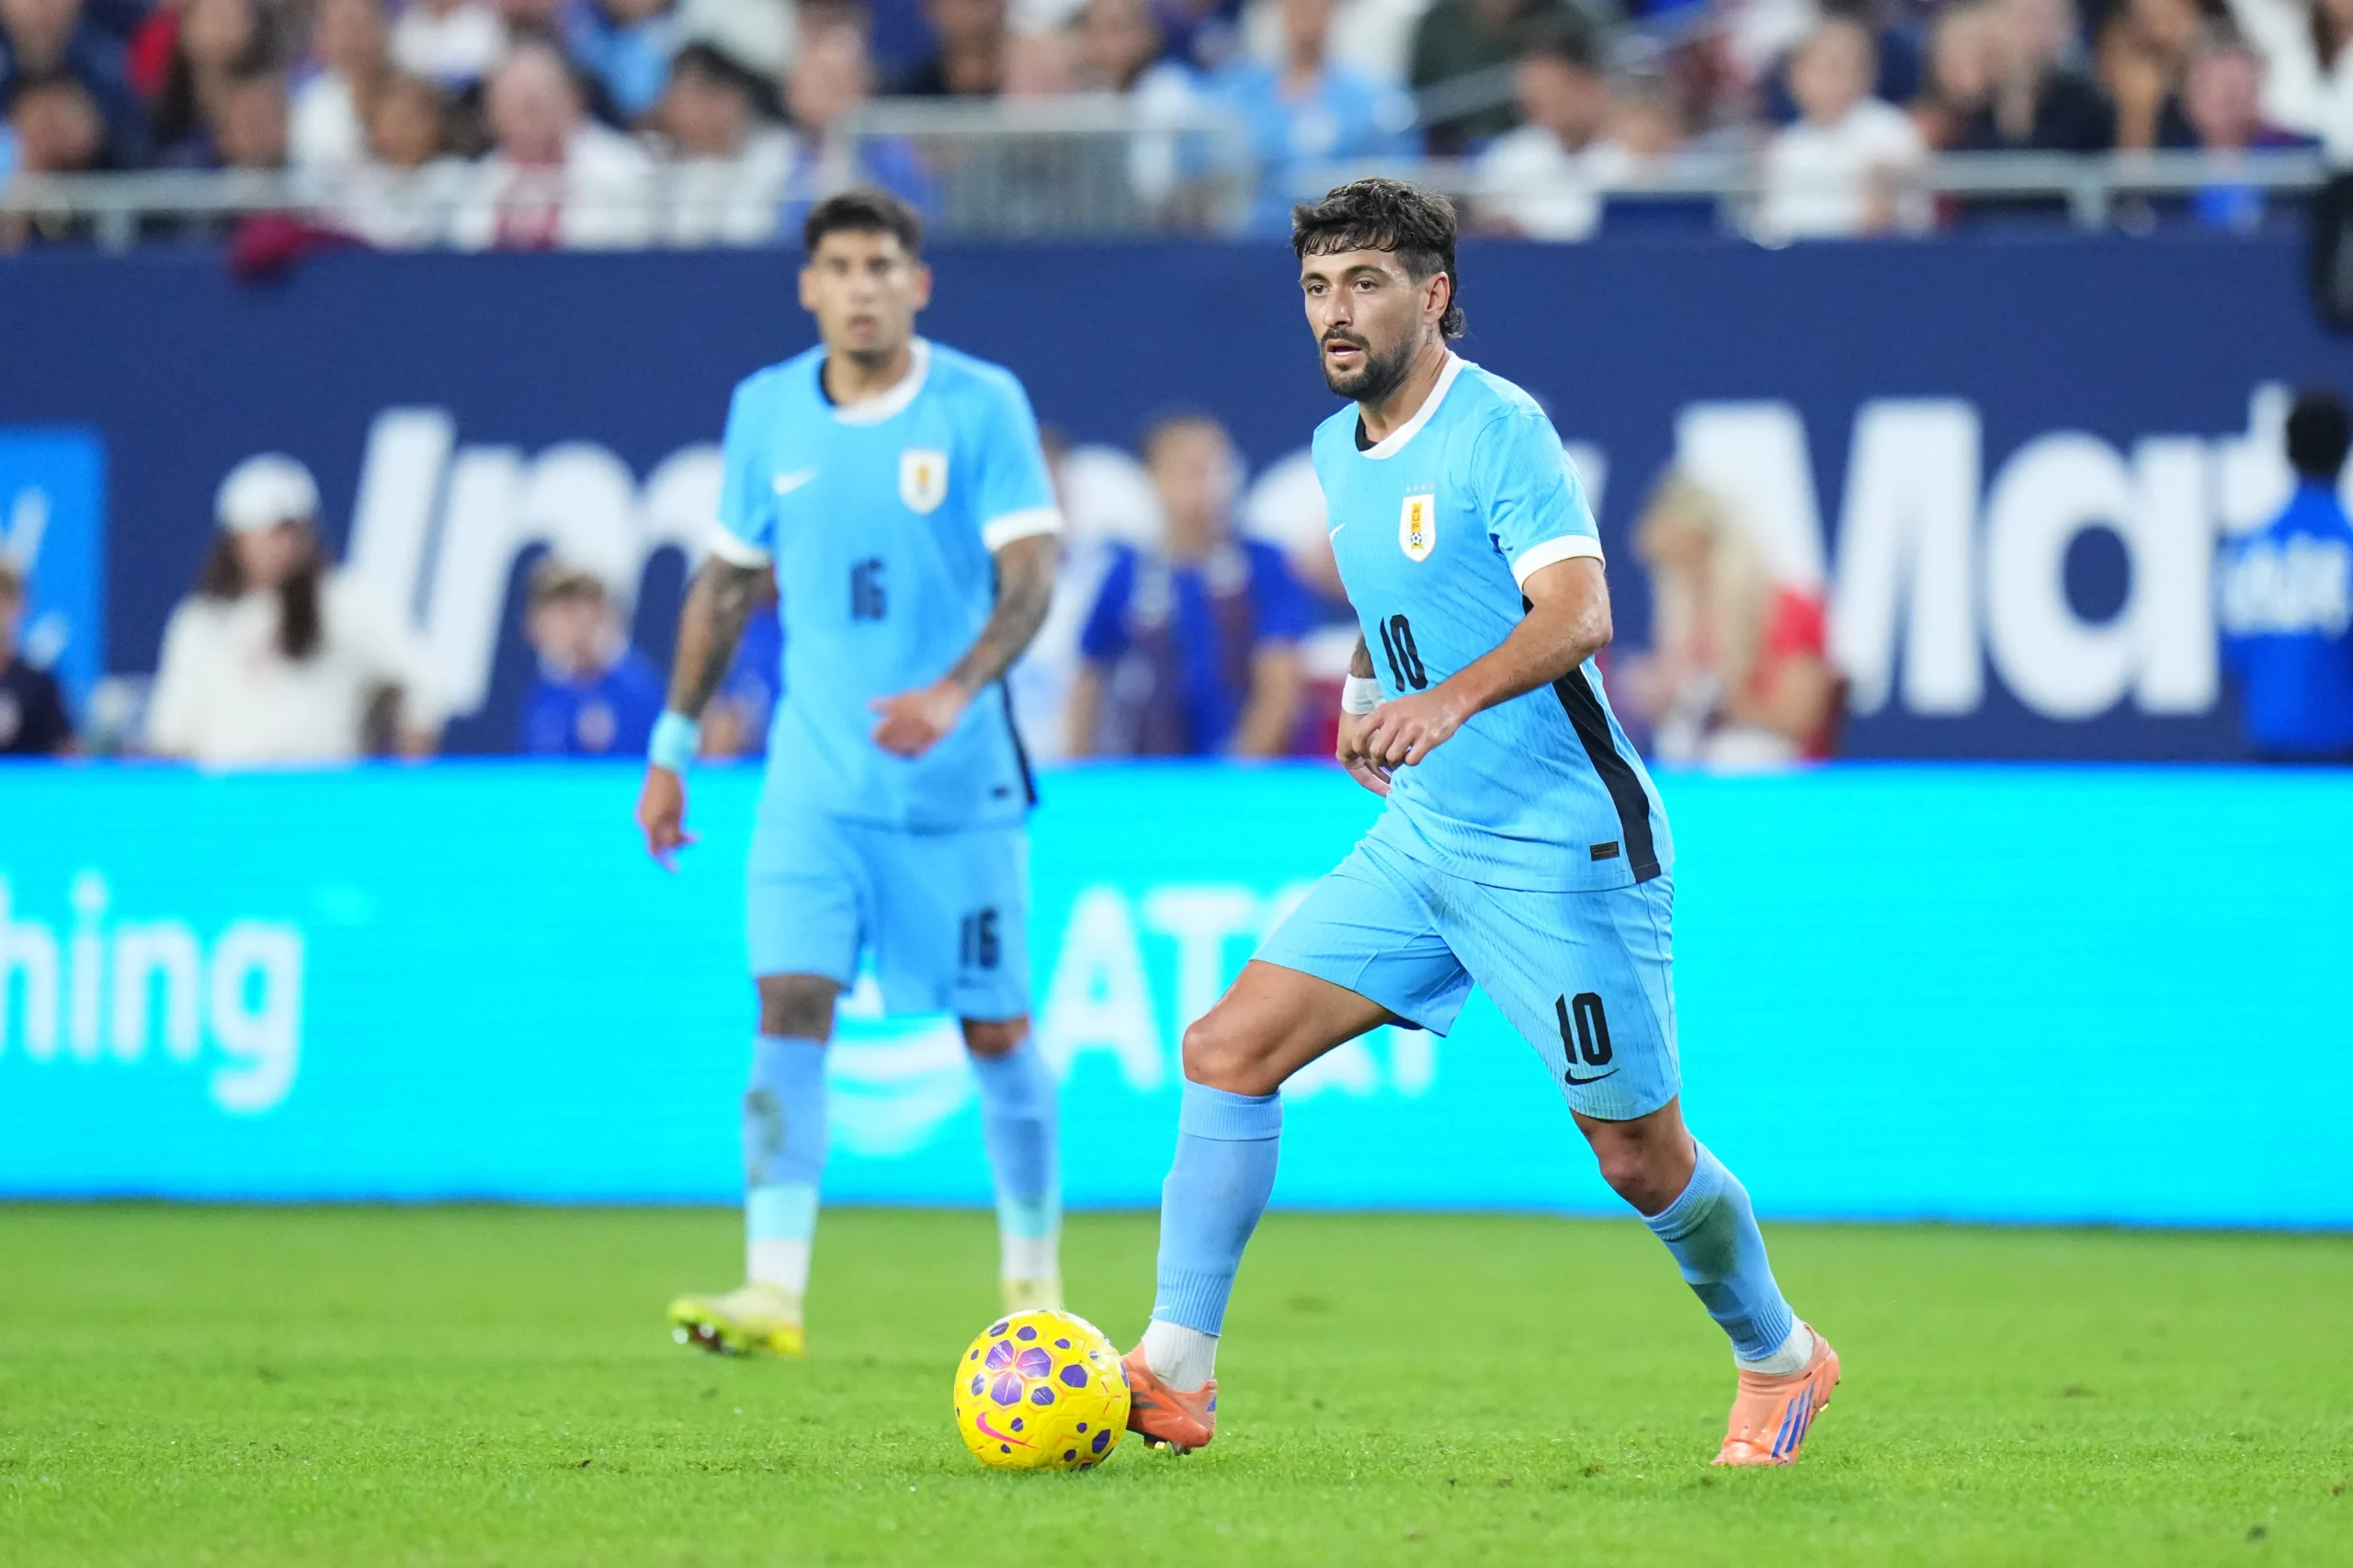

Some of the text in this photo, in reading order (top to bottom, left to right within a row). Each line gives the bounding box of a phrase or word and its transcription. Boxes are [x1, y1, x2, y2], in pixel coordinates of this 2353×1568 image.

[1411, 506, 1420, 530] AUF
[1380, 614, 1428, 692] 10
[1555, 992, 1613, 1066] 10
